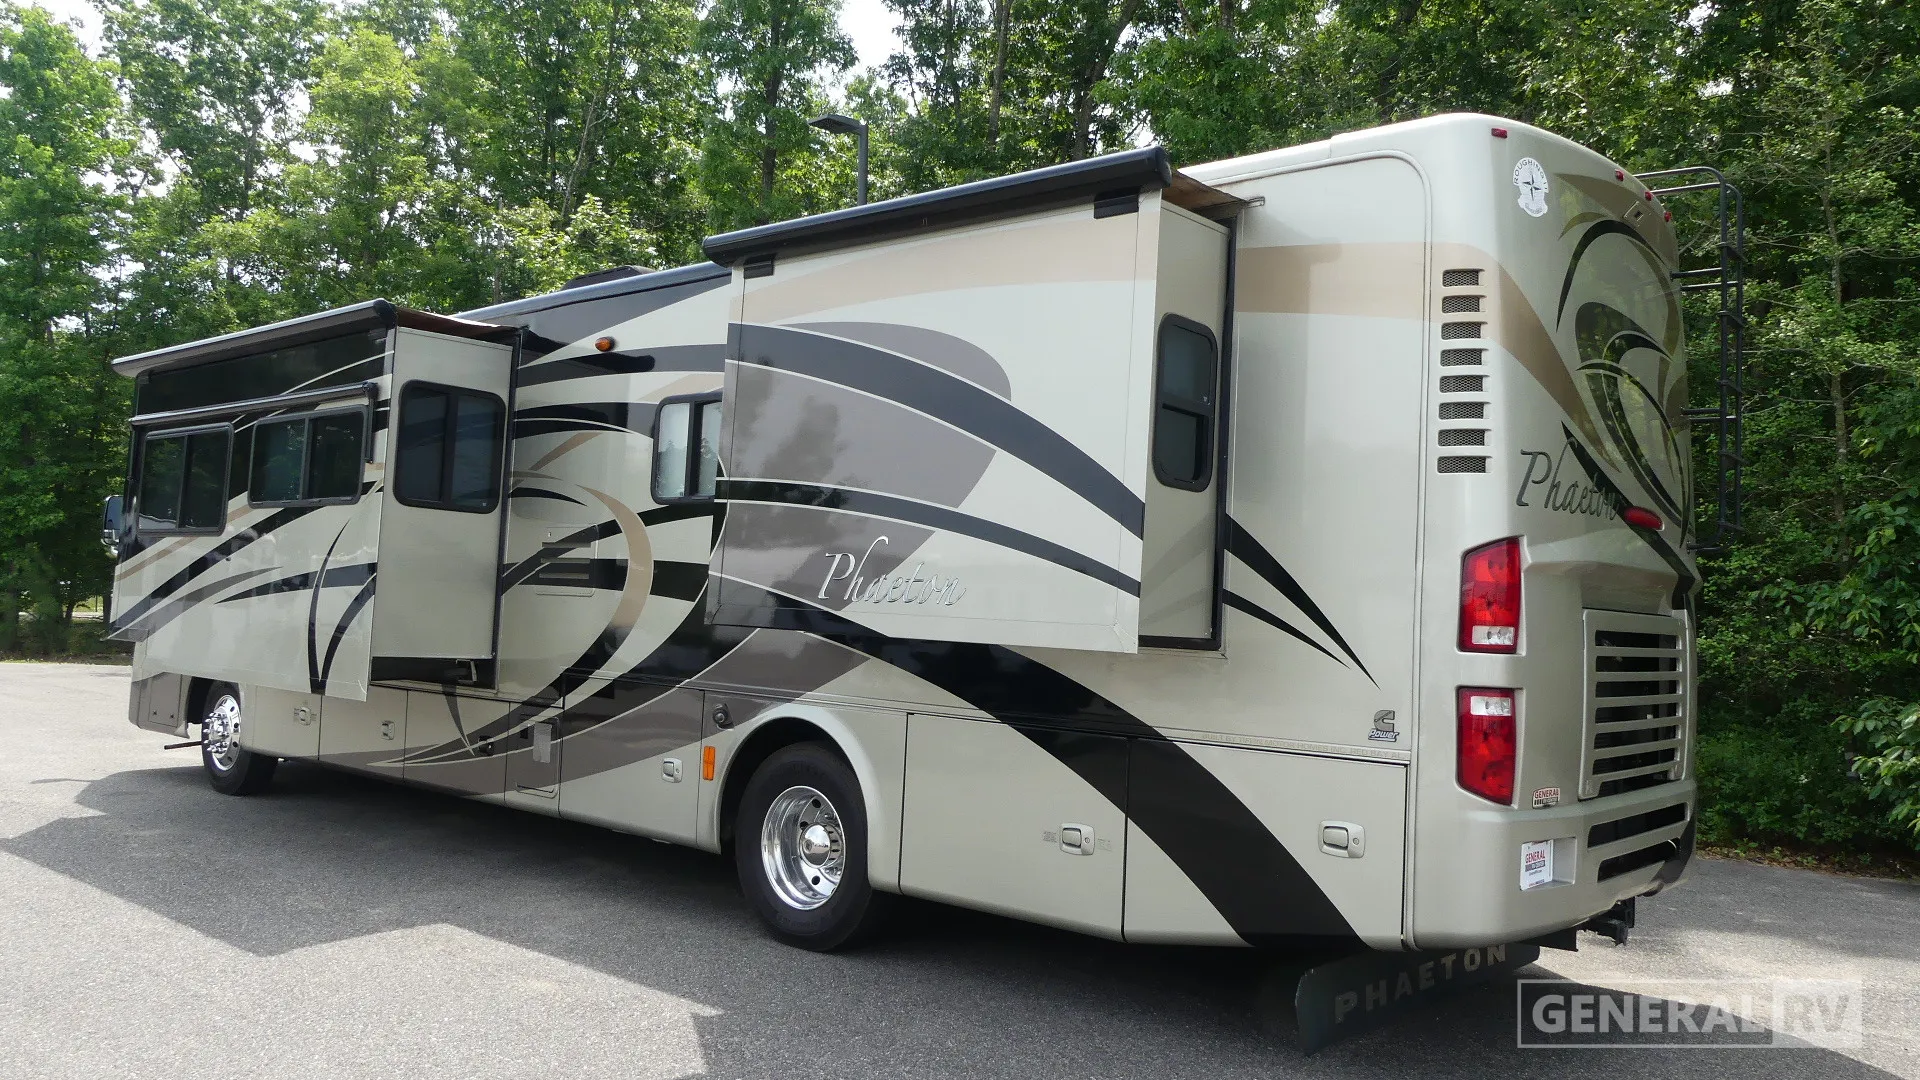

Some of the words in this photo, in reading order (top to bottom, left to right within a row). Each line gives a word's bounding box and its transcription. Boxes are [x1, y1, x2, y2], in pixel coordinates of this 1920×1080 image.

[1515, 437, 1621, 521] Phaeton
[817, 535, 966, 606] Phaeton
[1369, 729, 1399, 739] Power
[1534, 789, 1559, 799] GENERAL
[1525, 849, 1545, 864] GENERAL
[1334, 943, 1506, 1024] PHAETON
